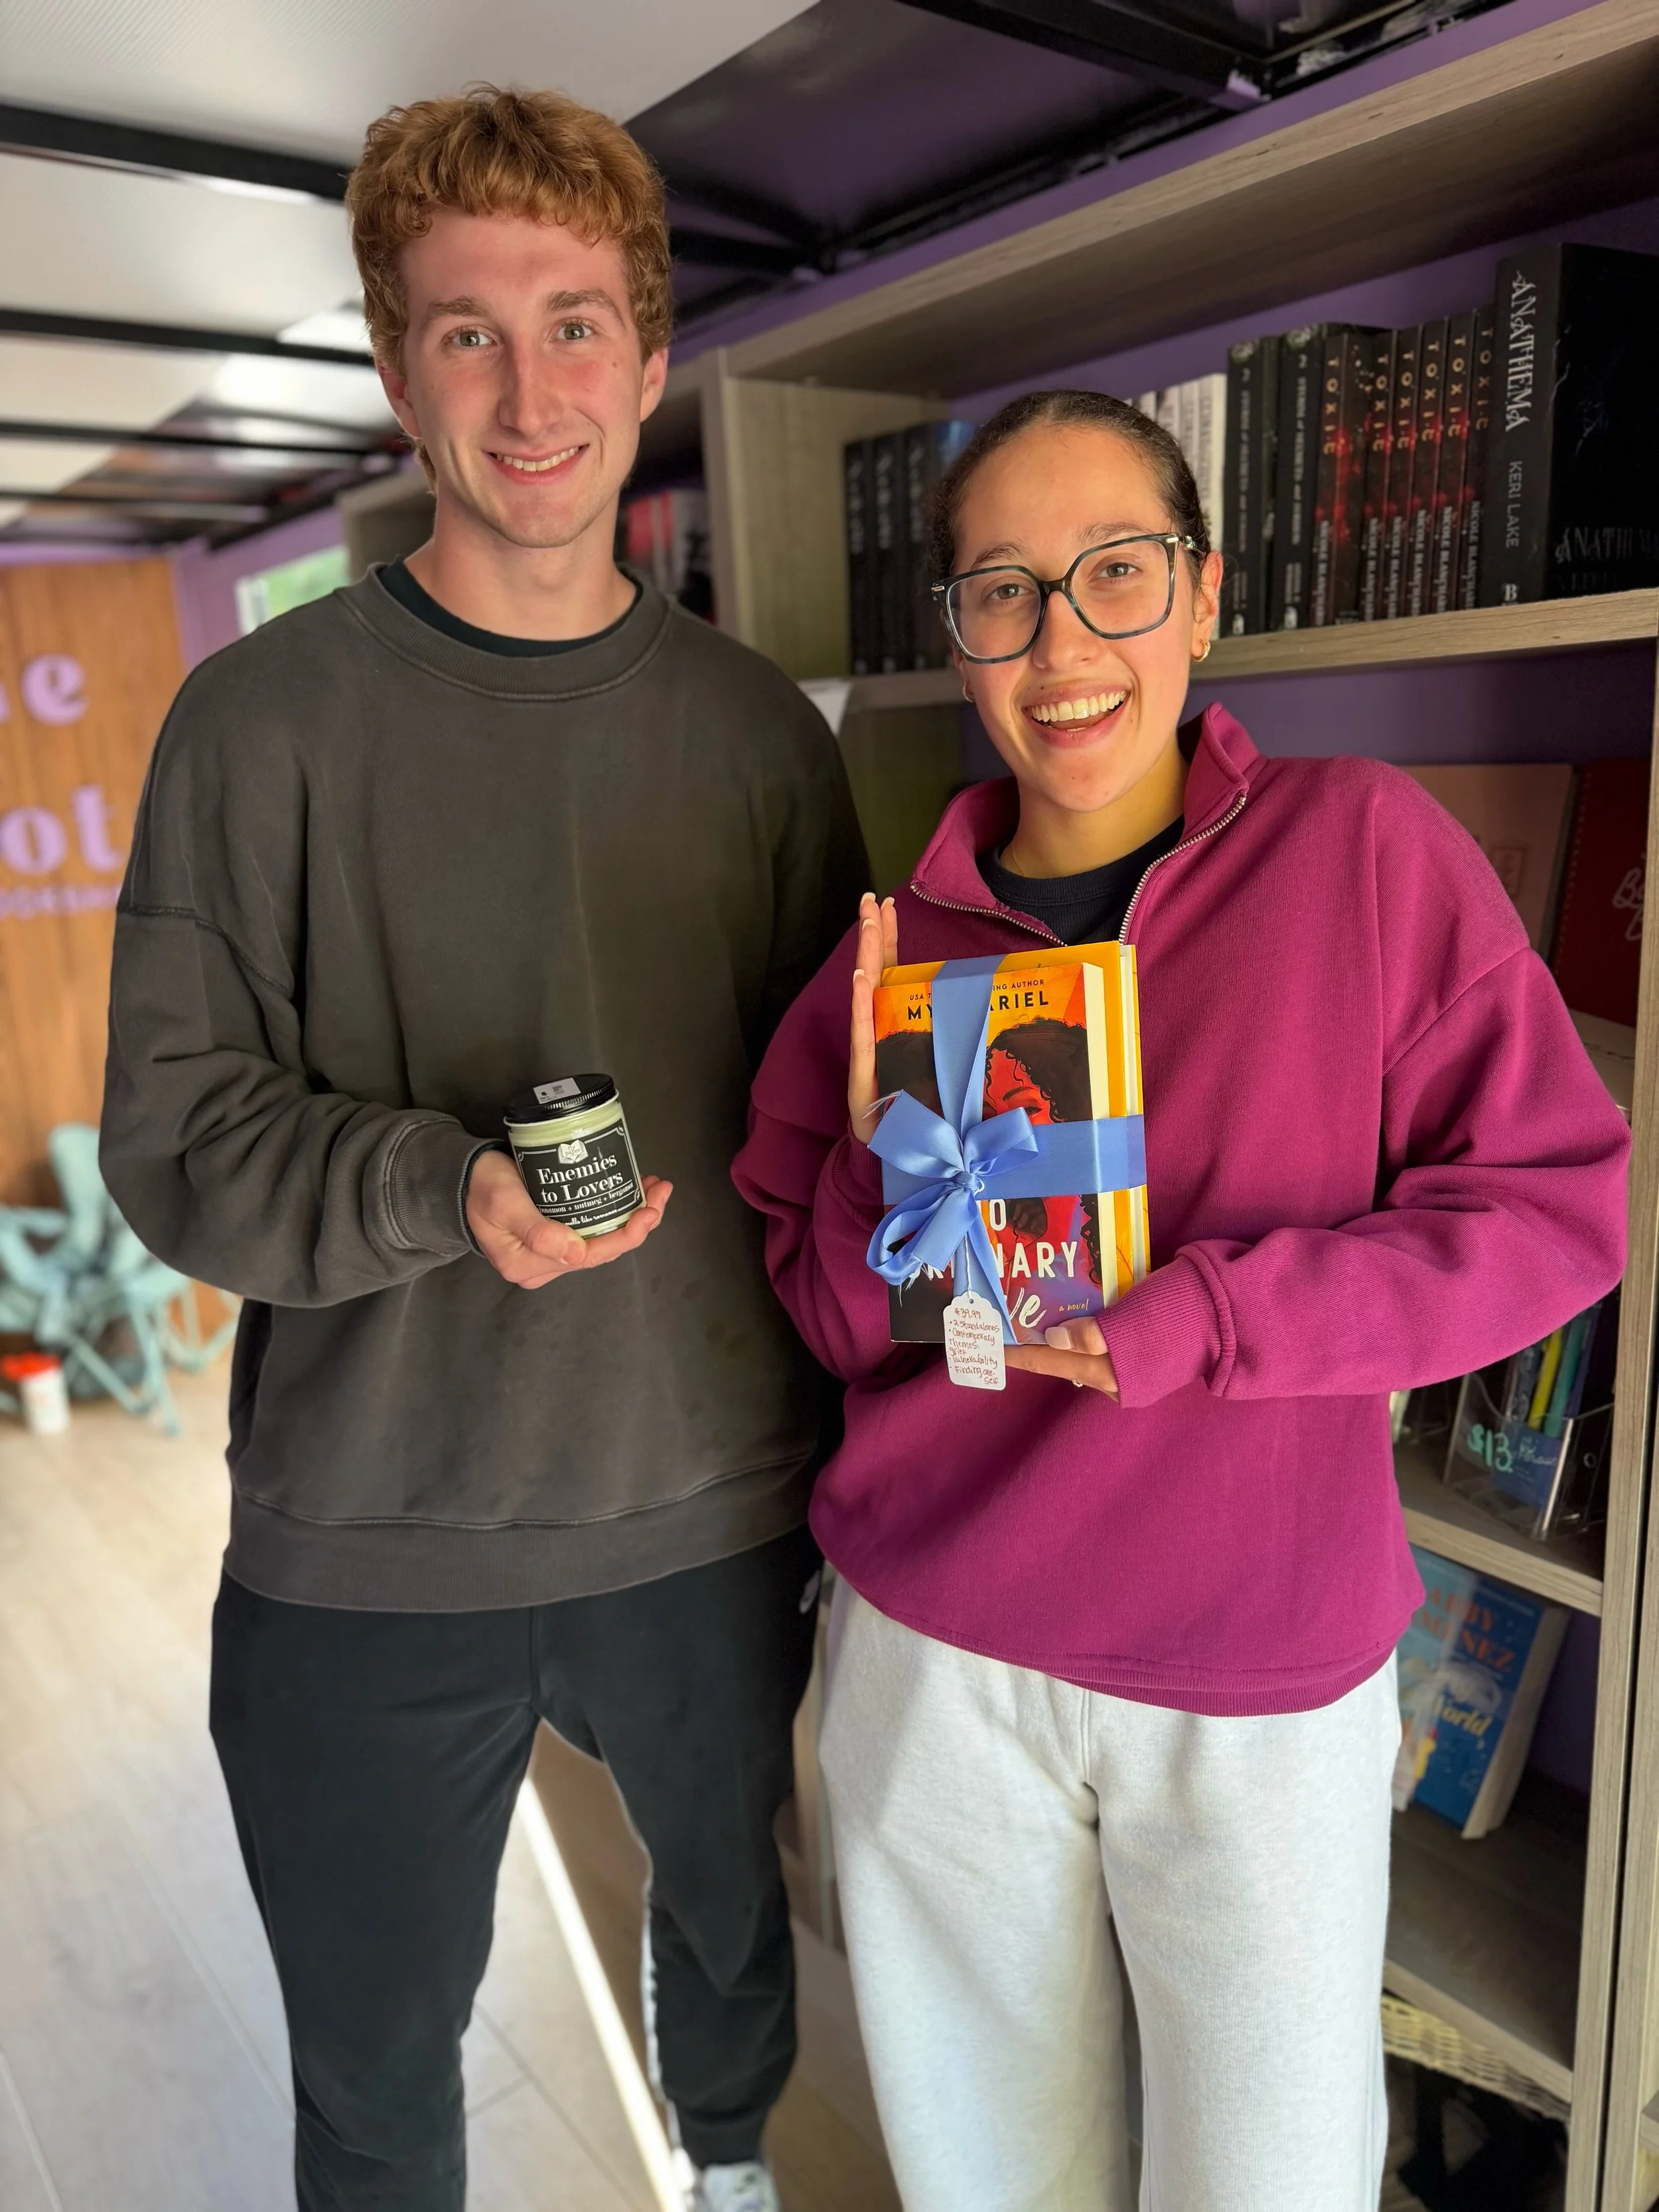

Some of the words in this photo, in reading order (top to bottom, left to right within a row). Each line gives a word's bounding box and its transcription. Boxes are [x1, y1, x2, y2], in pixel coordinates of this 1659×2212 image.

[1506, 271, 1536, 431] ANATHEMA
[1508, 461, 1523, 498] KERI
[1440, 506, 1453, 549] NICOLE
[1469, 500, 1481, 544] NICOLE
[1505, 503, 1521, 549] LAKE
[0, 653, 88, 726] e
[1011, 979, 1044, 989] AUTHOR
[908, 1003, 932, 1020] MY
[536, 1154, 617, 1185] Enemies
[541, 1188, 558, 1203] to
[560, 1172, 623, 1201] Lovers
[574, 1197, 603, 1209] nutmeg
[609, 1183, 634, 1200] bergamot
[565, 1217, 581, 1226] mells
[954, 1307, 981, 1319] $39.99
[1067, 1298, 1089, 1311] novel
[953, 1319, 960, 1327] 2
[954, 1365, 982, 1378] Finding
